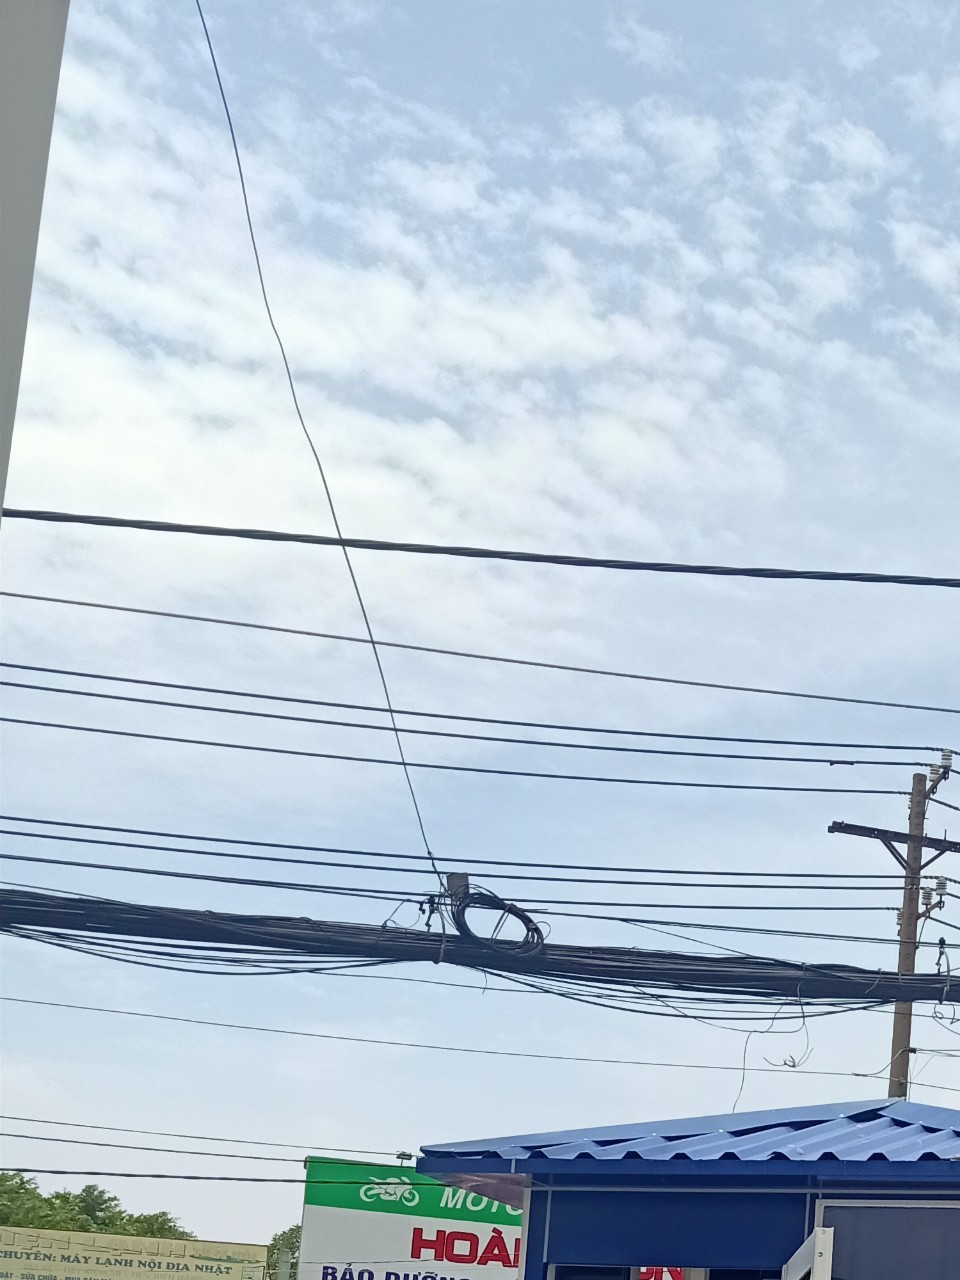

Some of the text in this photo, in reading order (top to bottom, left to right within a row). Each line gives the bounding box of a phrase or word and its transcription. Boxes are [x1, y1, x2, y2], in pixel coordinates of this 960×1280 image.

[410, 1227, 521, 1268] HOÀ
[60, 1253, 92, 1264] MÁY
[95, 1256, 133, 1268] LẠNH
[137, 1256, 162, 1271] NỘI
[194, 1264, 233, 1276] NHẬT
